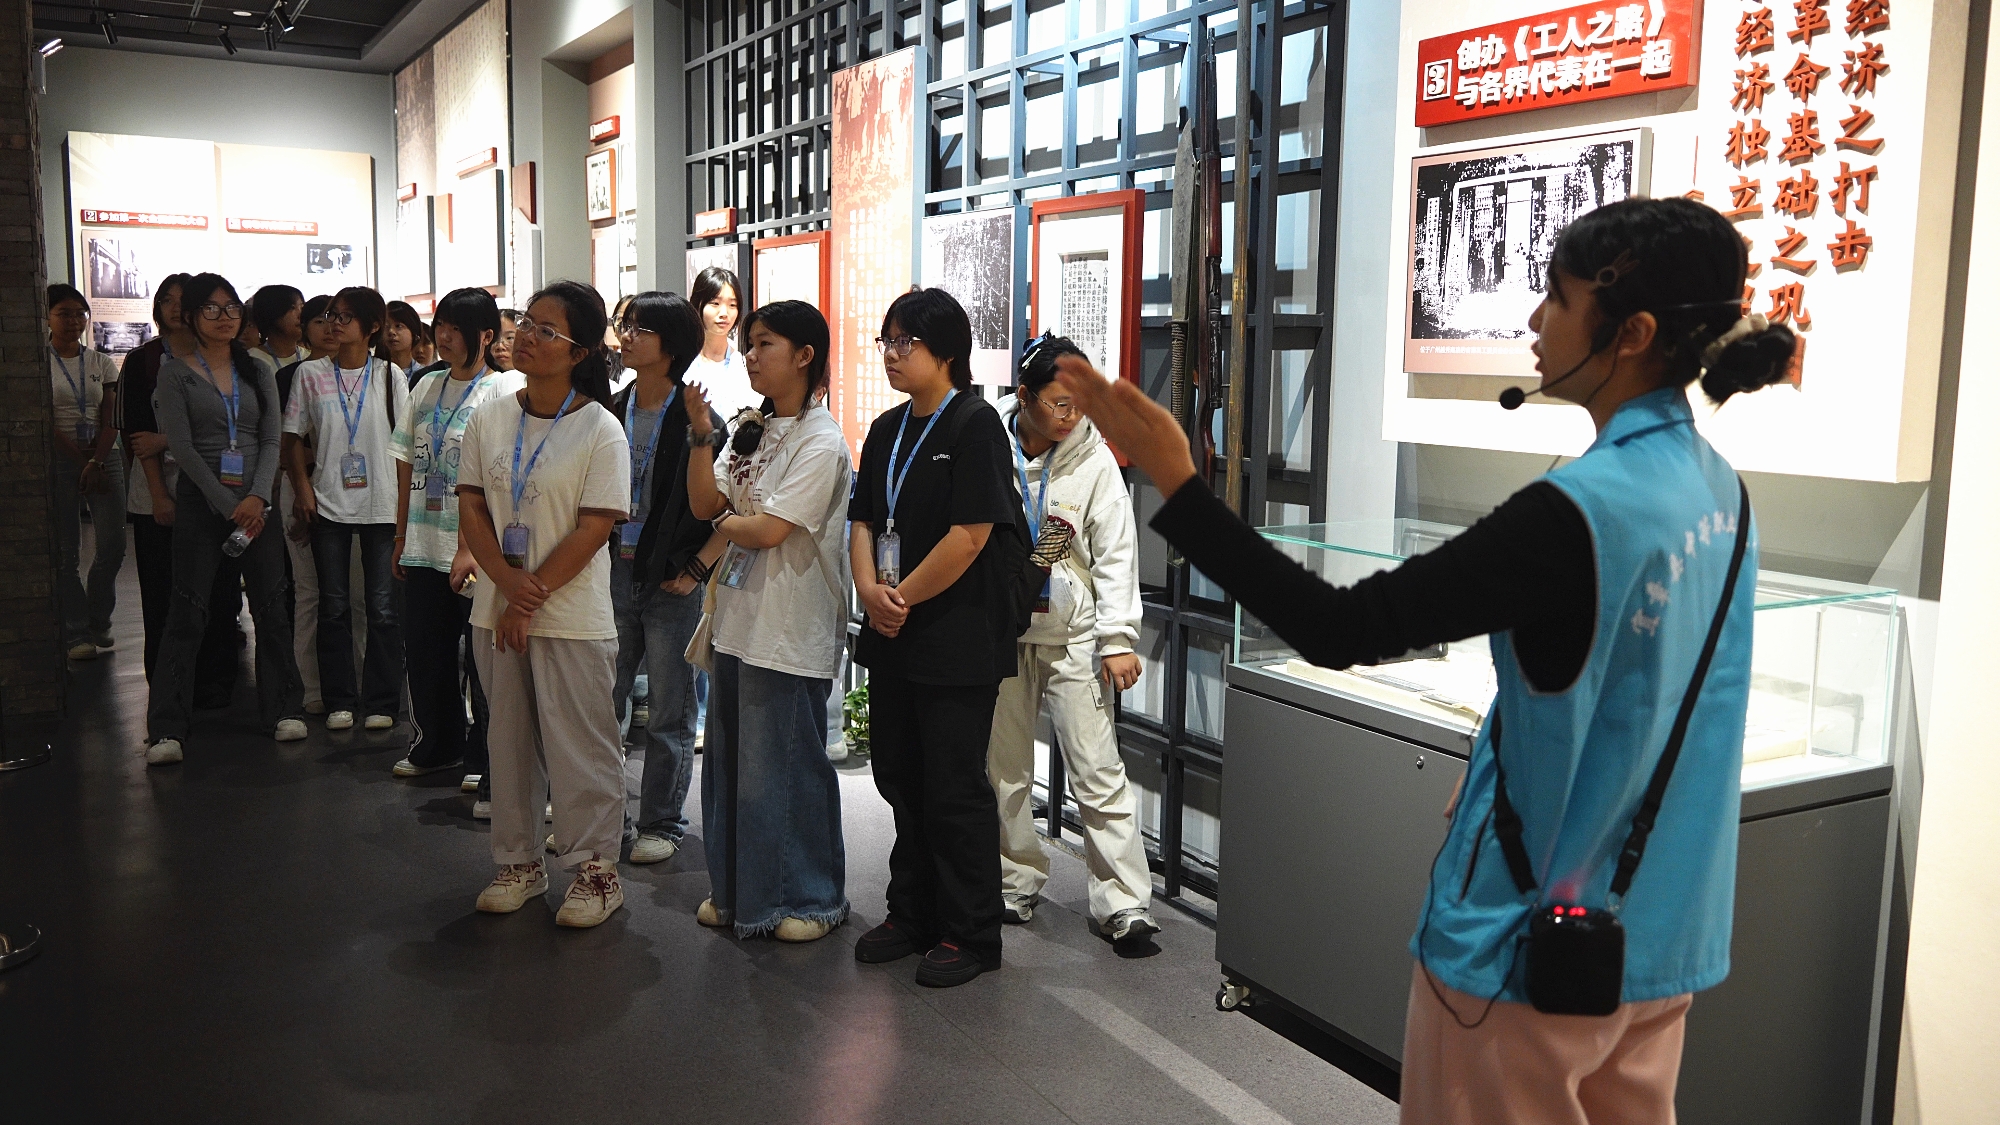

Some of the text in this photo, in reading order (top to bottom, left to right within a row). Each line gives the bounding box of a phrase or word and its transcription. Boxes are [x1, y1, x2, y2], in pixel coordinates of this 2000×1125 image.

[1457, 0, 1666, 71] 创办《工人之路》
[1426, 64, 1446, 95] 3
[1454, 40, 1672, 105] 与各界代表在一起
[1765, 0, 1830, 384] 革命基础之巩
